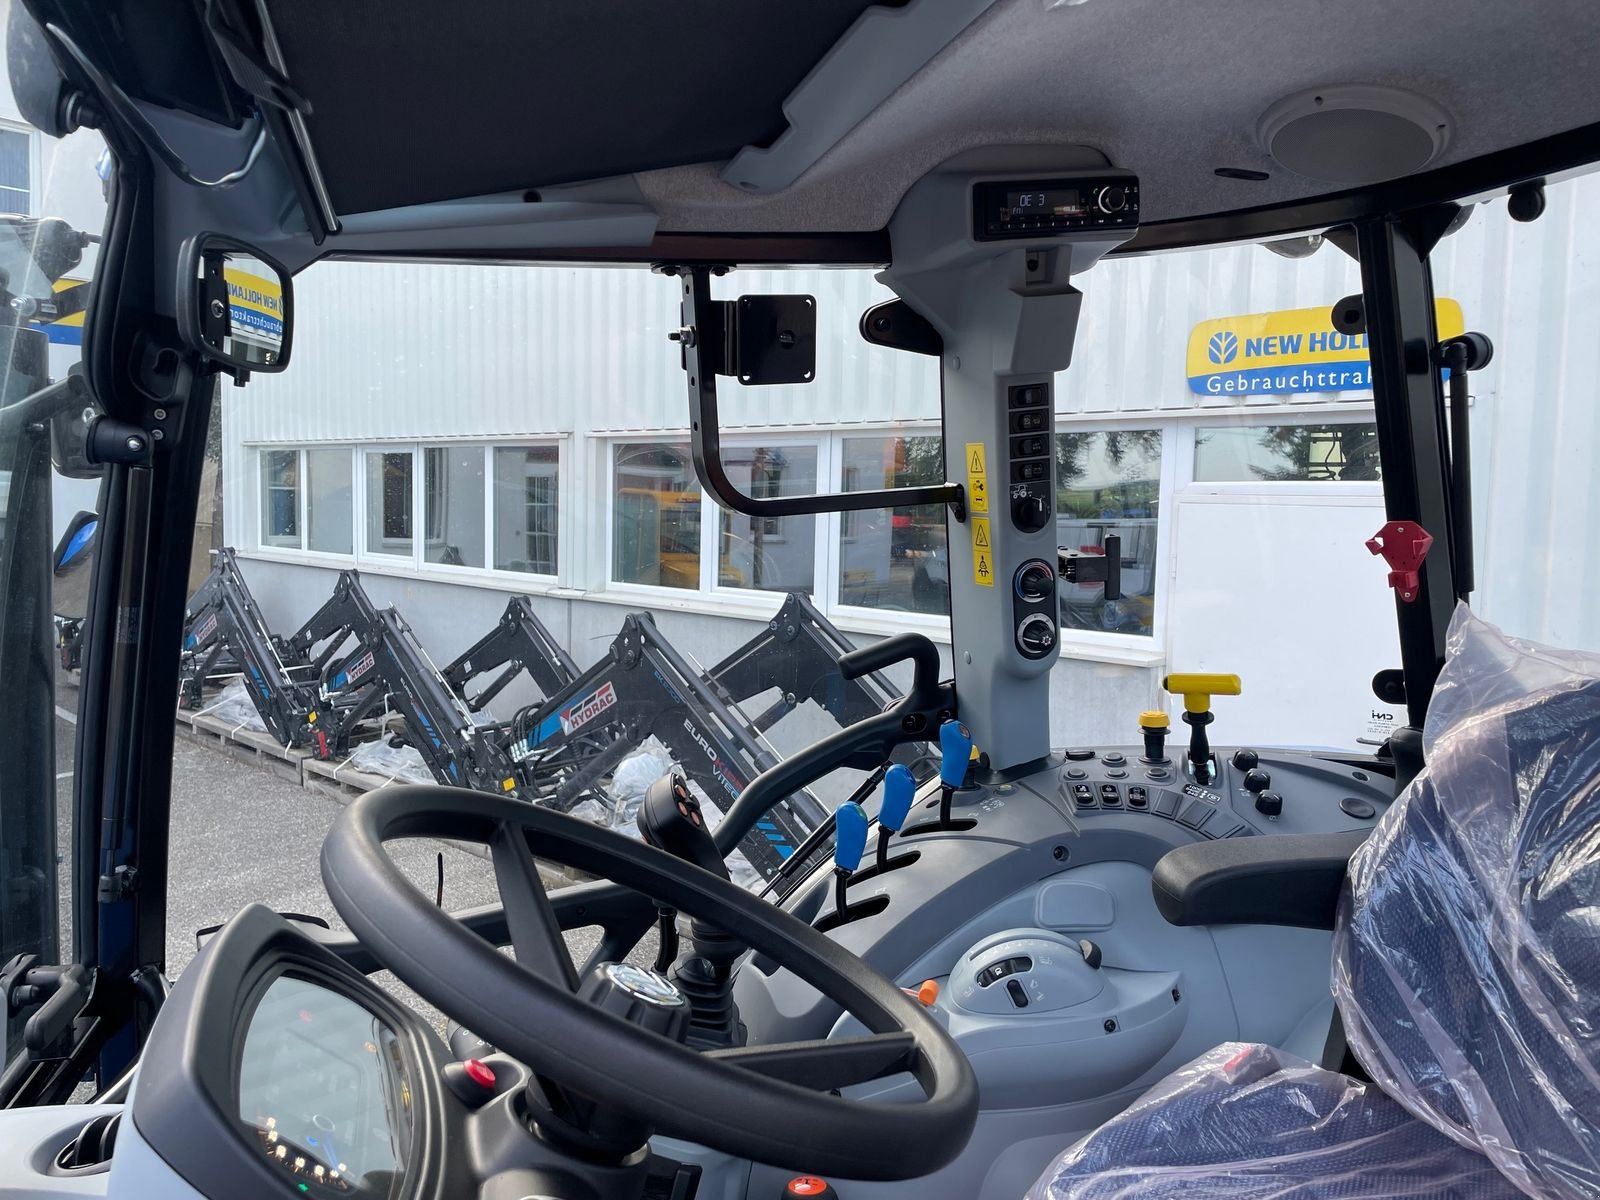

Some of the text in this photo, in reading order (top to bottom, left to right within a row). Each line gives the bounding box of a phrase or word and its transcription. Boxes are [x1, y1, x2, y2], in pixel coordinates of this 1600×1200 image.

[1245, 334, 1303, 358] NEW
[351, 659, 374, 680] HYDRAC
[570, 692, 614, 729] HYDRAC
